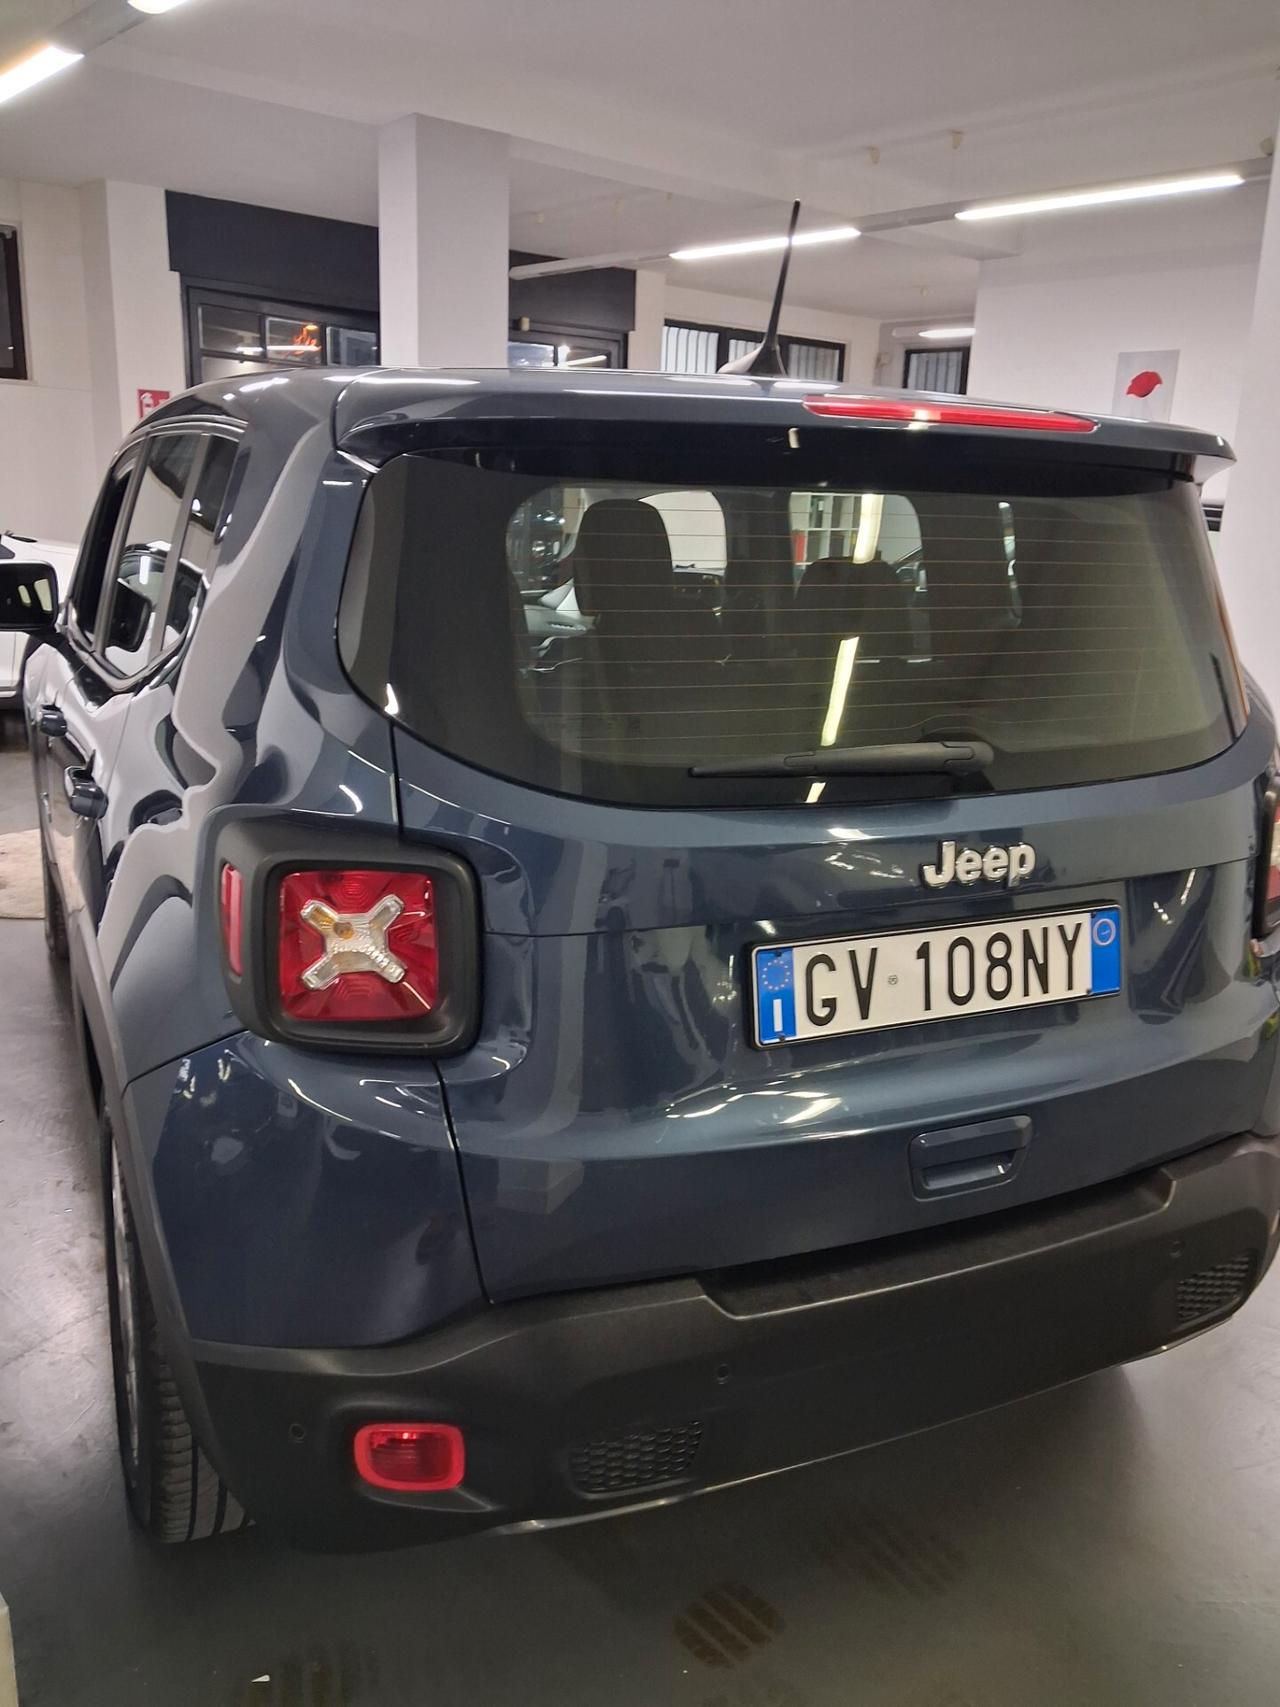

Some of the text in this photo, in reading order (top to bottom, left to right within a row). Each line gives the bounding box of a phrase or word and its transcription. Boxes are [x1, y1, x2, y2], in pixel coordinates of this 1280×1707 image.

[922, 840, 1036, 888] Jeep
[805, 922, 1082, 1026] GV 108NY
[772, 998, 784, 1033] I
